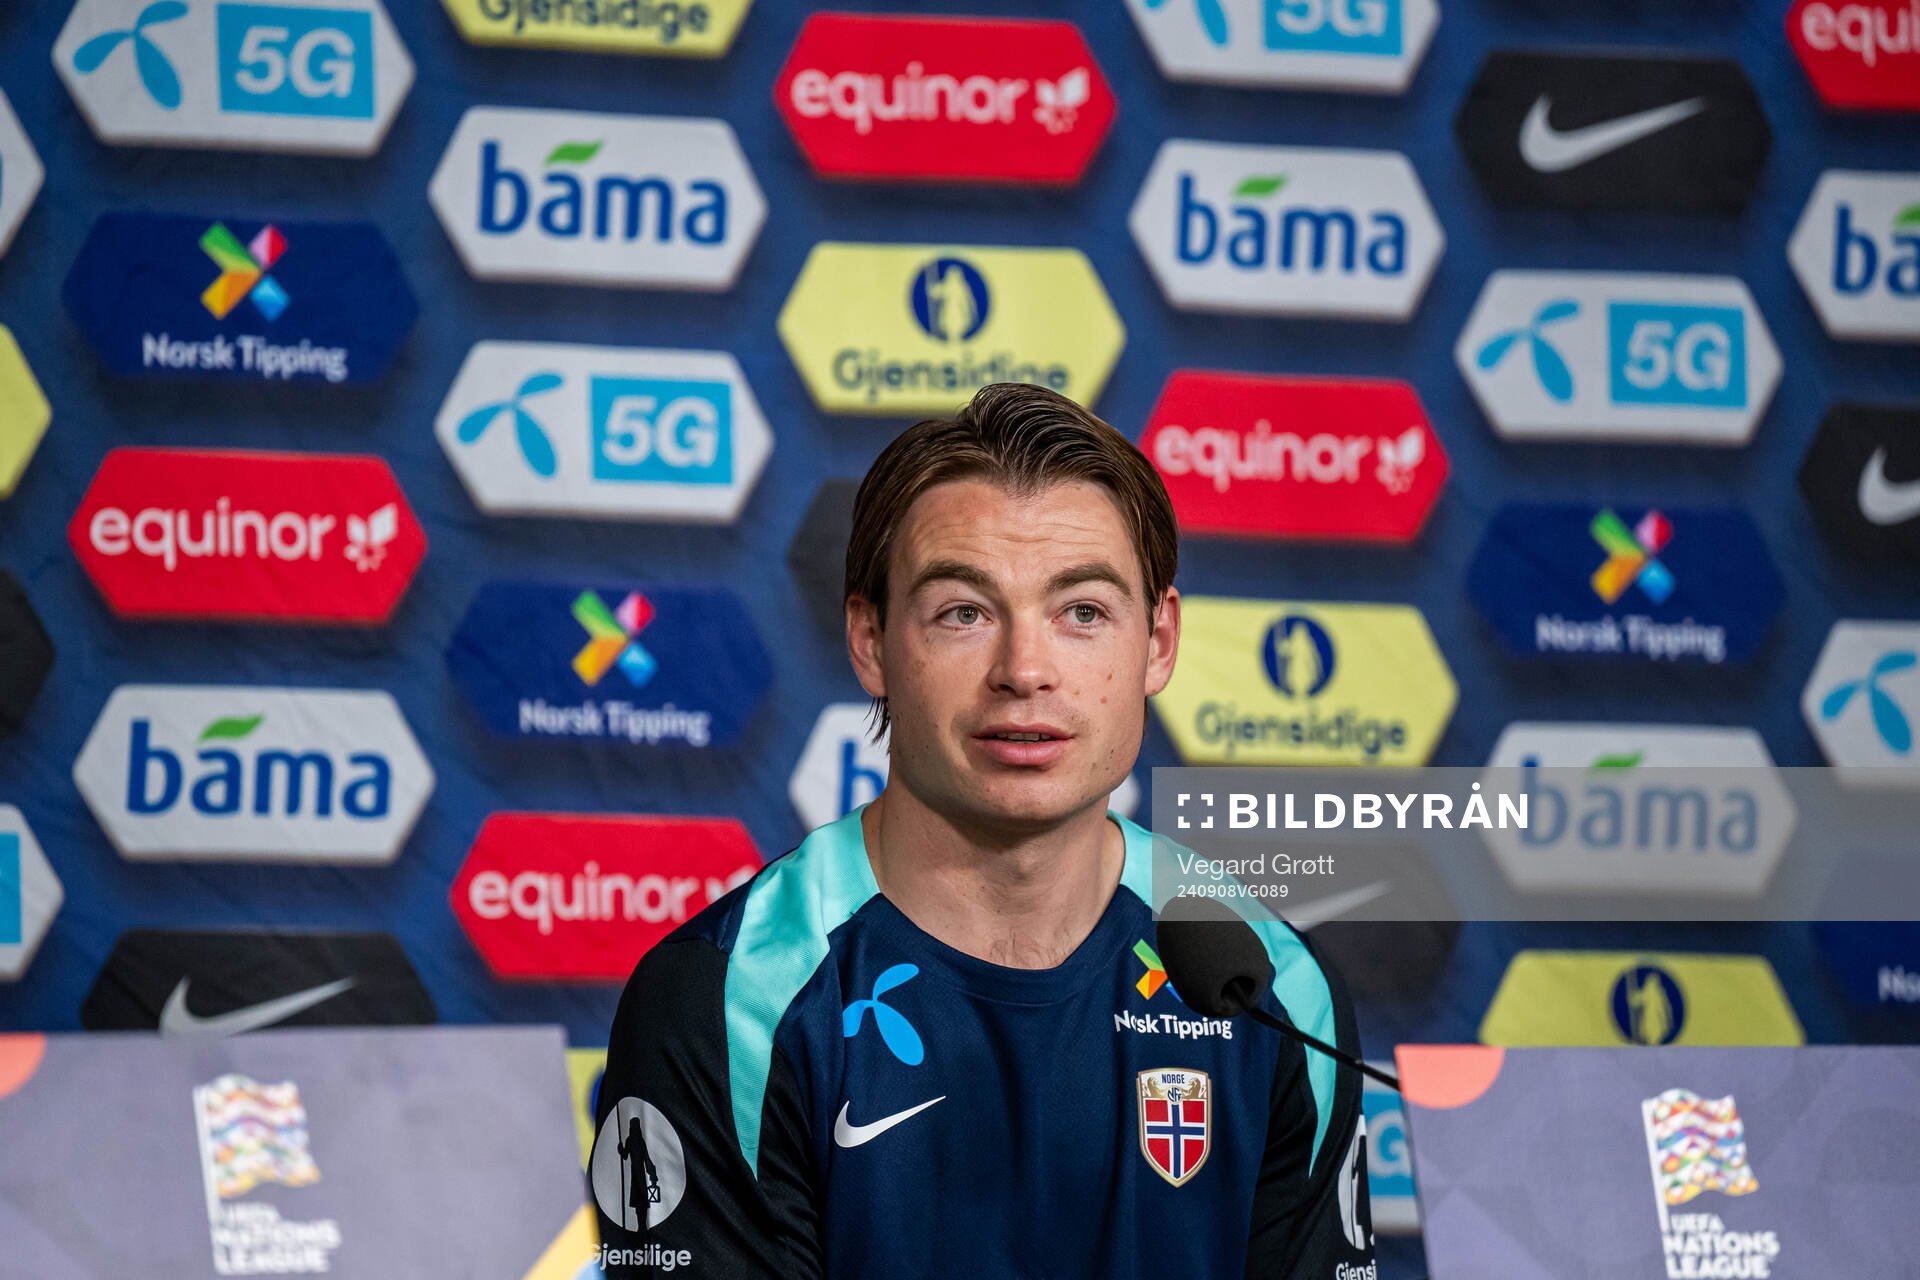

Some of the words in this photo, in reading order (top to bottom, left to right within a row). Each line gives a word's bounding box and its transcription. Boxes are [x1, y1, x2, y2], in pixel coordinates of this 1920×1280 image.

[234, 25, 356, 99] 5G
[791, 61, 1028, 135] equinor
[477, 140, 729, 247] bama
[1176, 172, 1406, 275] bama
[143, 333, 235, 370] Norsk
[239, 336, 347, 382] Tipping
[1624, 320, 1732, 392] 5G
[603, 394, 718, 470] 5G
[1153, 420, 1370, 490] equinor
[90, 496, 336, 571] equinor
[1536, 614, 1622, 650] Norsk
[1626, 616, 1724, 663] Tipping
[519, 699, 602, 735] Norsk
[606, 702, 709, 747] Tipping
[1195, 703, 1406, 765] Gjensidige
[126, 718, 391, 820] bama
[469, 860, 699, 935] equinor
[1114, 1009, 1160, 1034] Nsk
[1160, 1014, 1233, 1040] Tipping
[1161, 1073, 1185, 1084] NORGE
[1663, 1231, 1780, 1257] NATIONS
[1671, 1213, 1724, 1233] UEFA
[1667, 1255, 1771, 1280] LEAGUE
